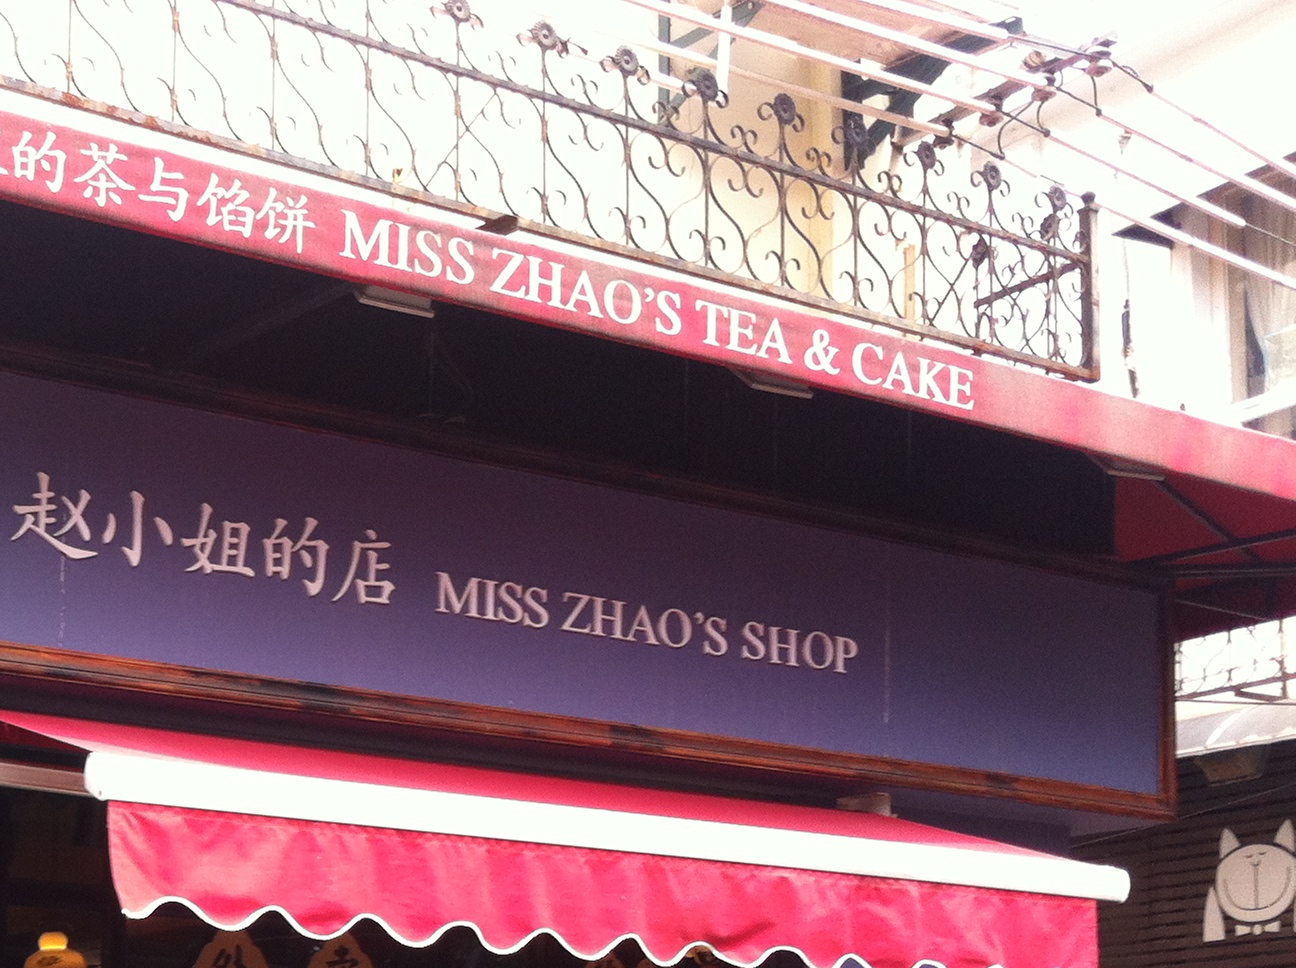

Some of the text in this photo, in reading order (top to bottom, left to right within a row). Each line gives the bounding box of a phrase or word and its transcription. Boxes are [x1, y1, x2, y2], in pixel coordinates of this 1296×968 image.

[340, 209, 975, 411] MISS ZHAO'S TEA & CAKE
[10, 471, 396, 605] 赵小姐的店
[435, 571, 860, 675] MISS ZHAO'S SHOP
